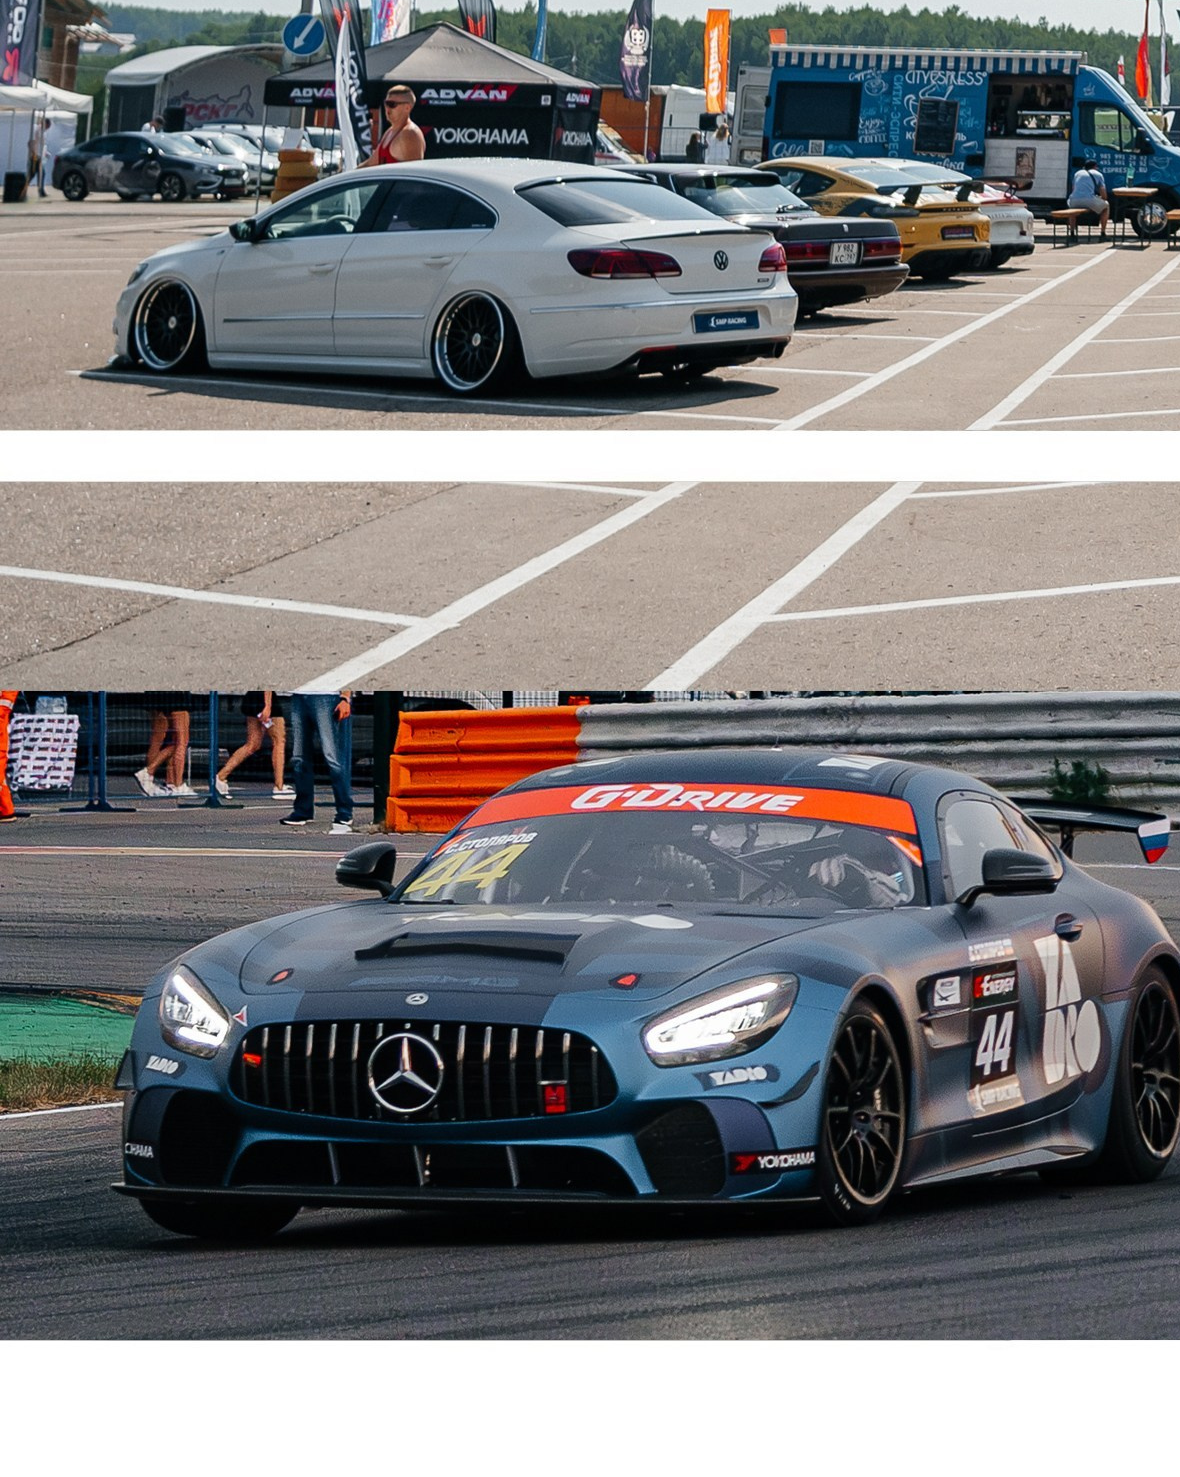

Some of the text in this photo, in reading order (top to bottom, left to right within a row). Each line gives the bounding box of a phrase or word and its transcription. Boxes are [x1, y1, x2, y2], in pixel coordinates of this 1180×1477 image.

[290, 88, 335, 99] ADVA
[421, 89, 507, 100] ADVAN
[566, 93, 590, 104] ADVAN
[434, 128, 529, 145] YOKOHAMA
[404, 844, 531, 897] 44
[975, 1010, 1014, 1076] 44
[757, 1151, 816, 1169] YOKOHAMA
